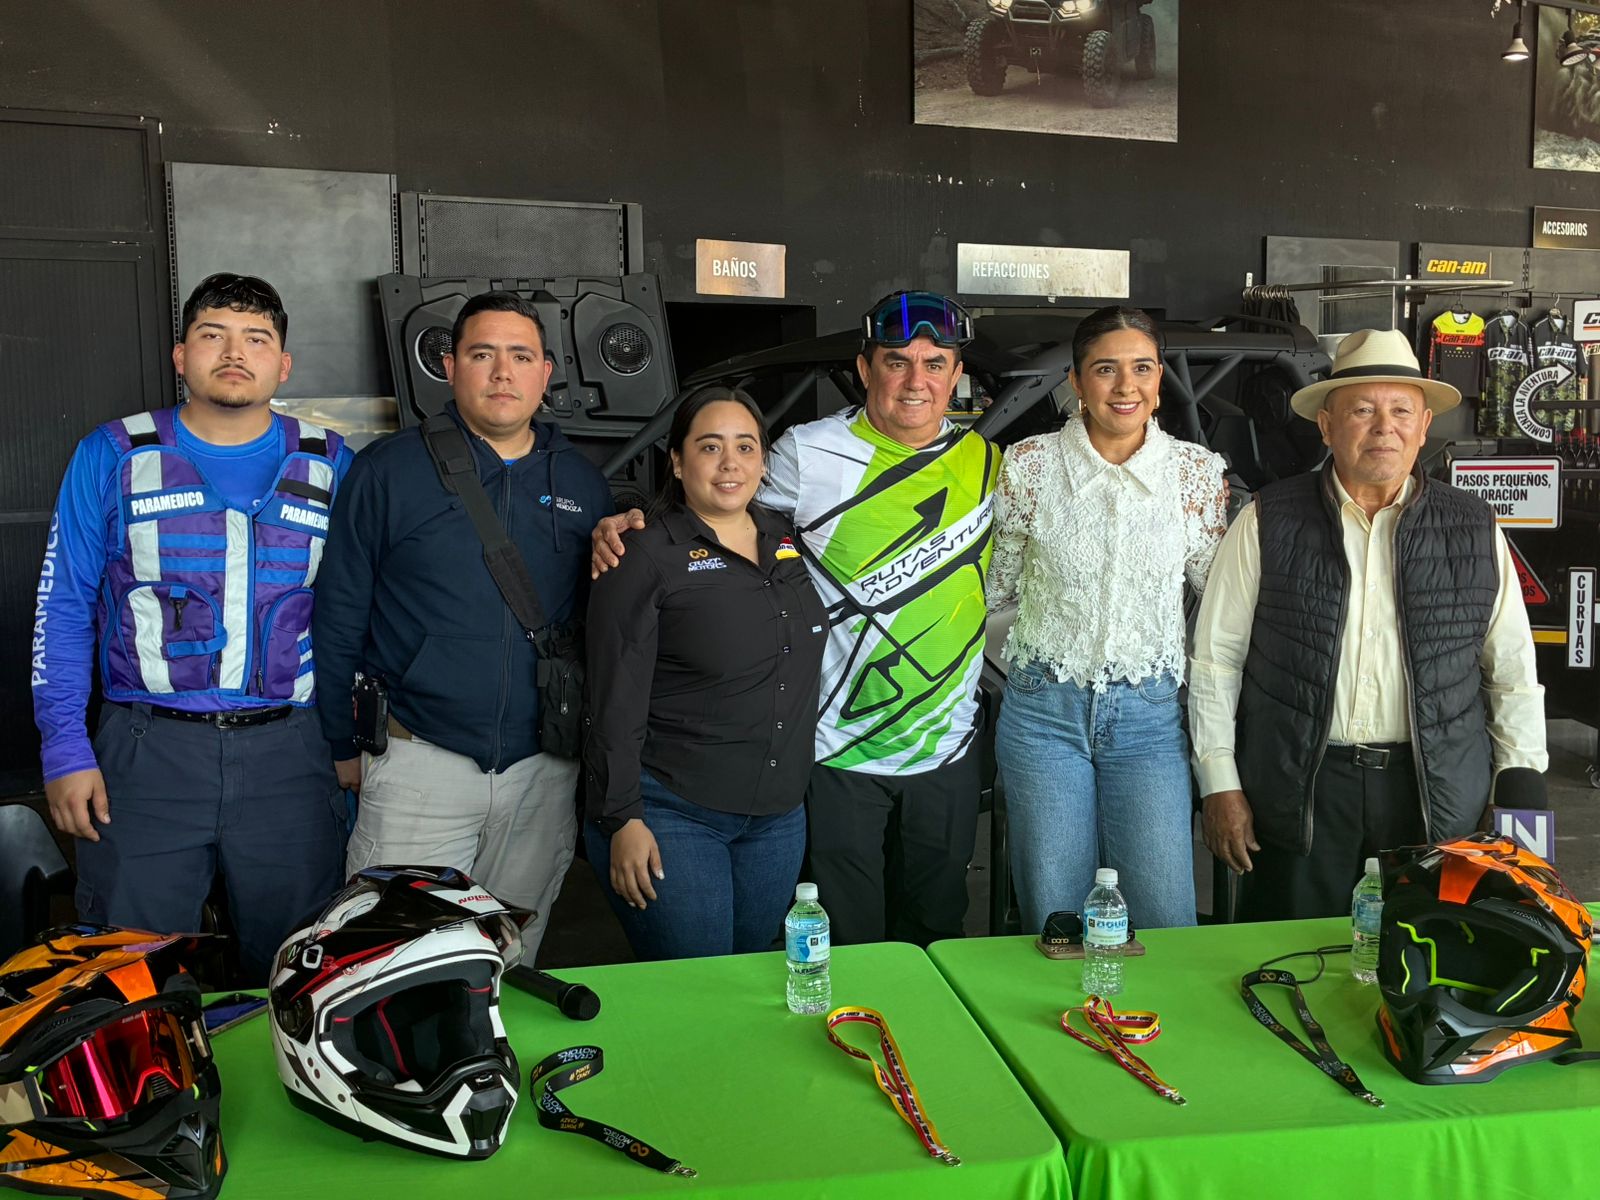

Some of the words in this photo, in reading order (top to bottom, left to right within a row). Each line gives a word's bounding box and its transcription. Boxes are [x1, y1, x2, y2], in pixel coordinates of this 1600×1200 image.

[1542, 221, 1588, 237] ACCESORIOS
[712, 256, 757, 278] BAÑOS
[972, 261, 1050, 279] REFACCIONES
[1427, 259, 1488, 275] can-am
[1519, 370, 1559, 397] AVENTURA
[1515, 398, 1526, 407] LA
[1516, 409, 1551, 439] COMIENZA
[1456, 474, 1490, 487] PASOS
[1493, 472, 1551, 488] PEQUEÑOS,
[131, 491, 204, 516] PARAMEDICO
[280, 504, 329, 530] PARAMEDIC
[860, 531, 946, 592] RUTAS
[1575, 575, 1586, 664] CURVAS
